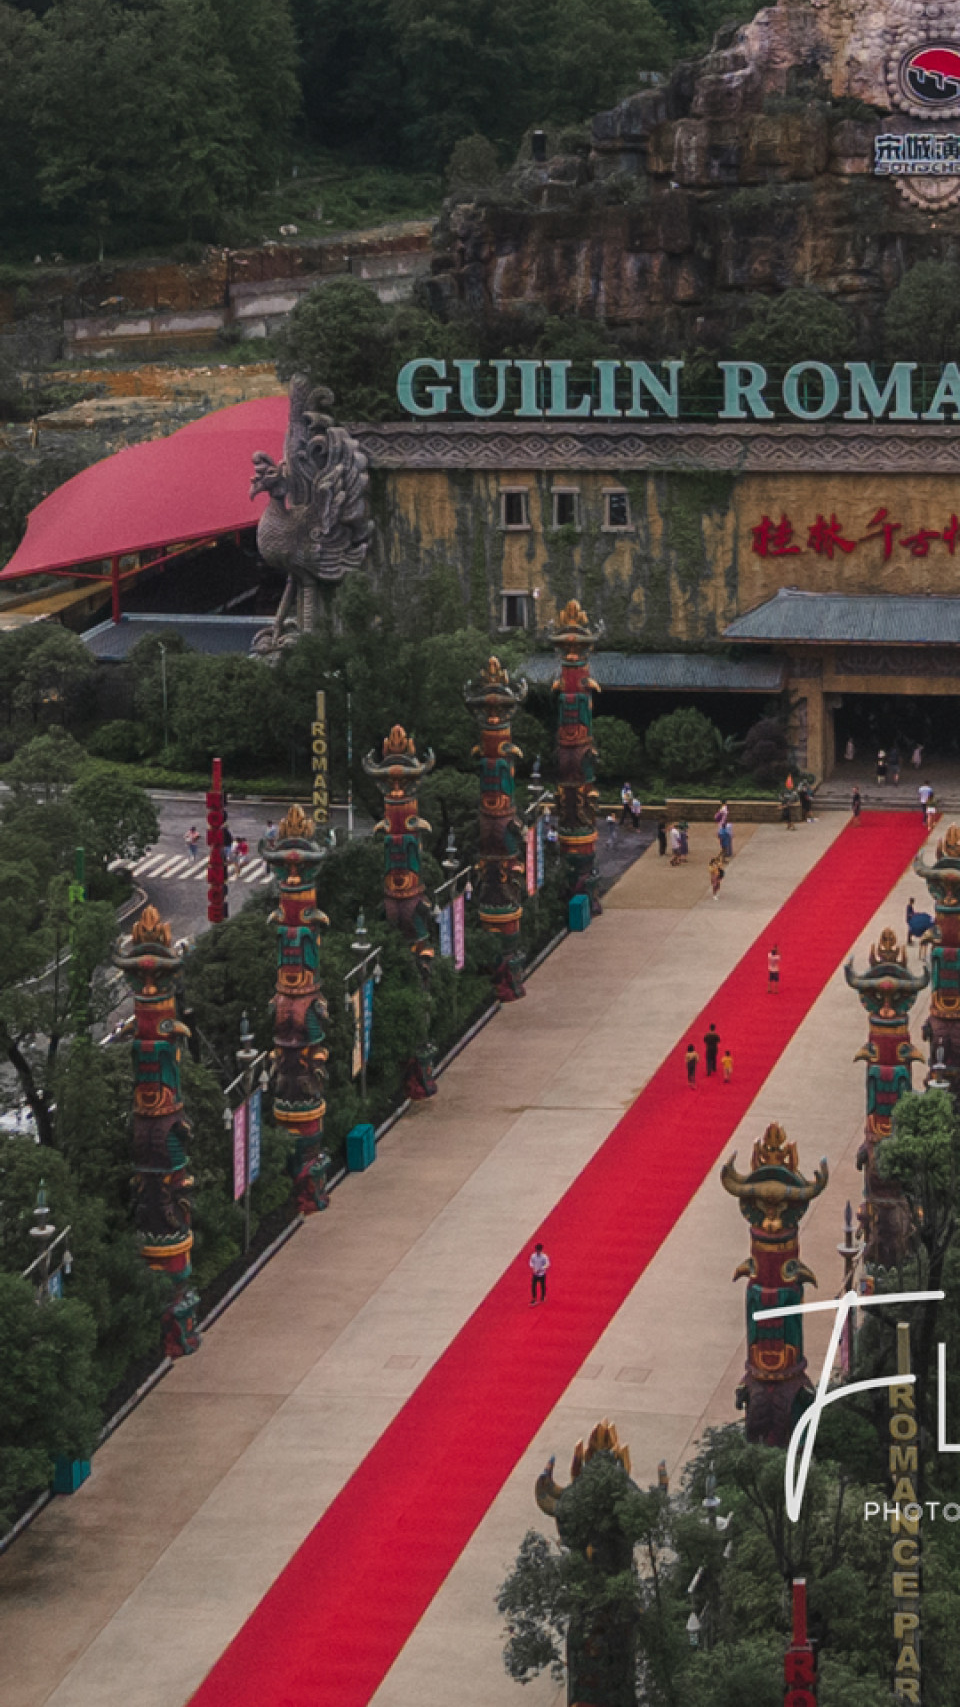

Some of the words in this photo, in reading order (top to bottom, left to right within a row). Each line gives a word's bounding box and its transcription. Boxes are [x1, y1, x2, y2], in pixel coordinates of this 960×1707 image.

[396, 358, 682, 416] GUILIN
[311, 721, 328, 823] ROMANC
[889, 1383, 919, 1598] ROMANCE
[893, 1612, 921, 1705] PAR
